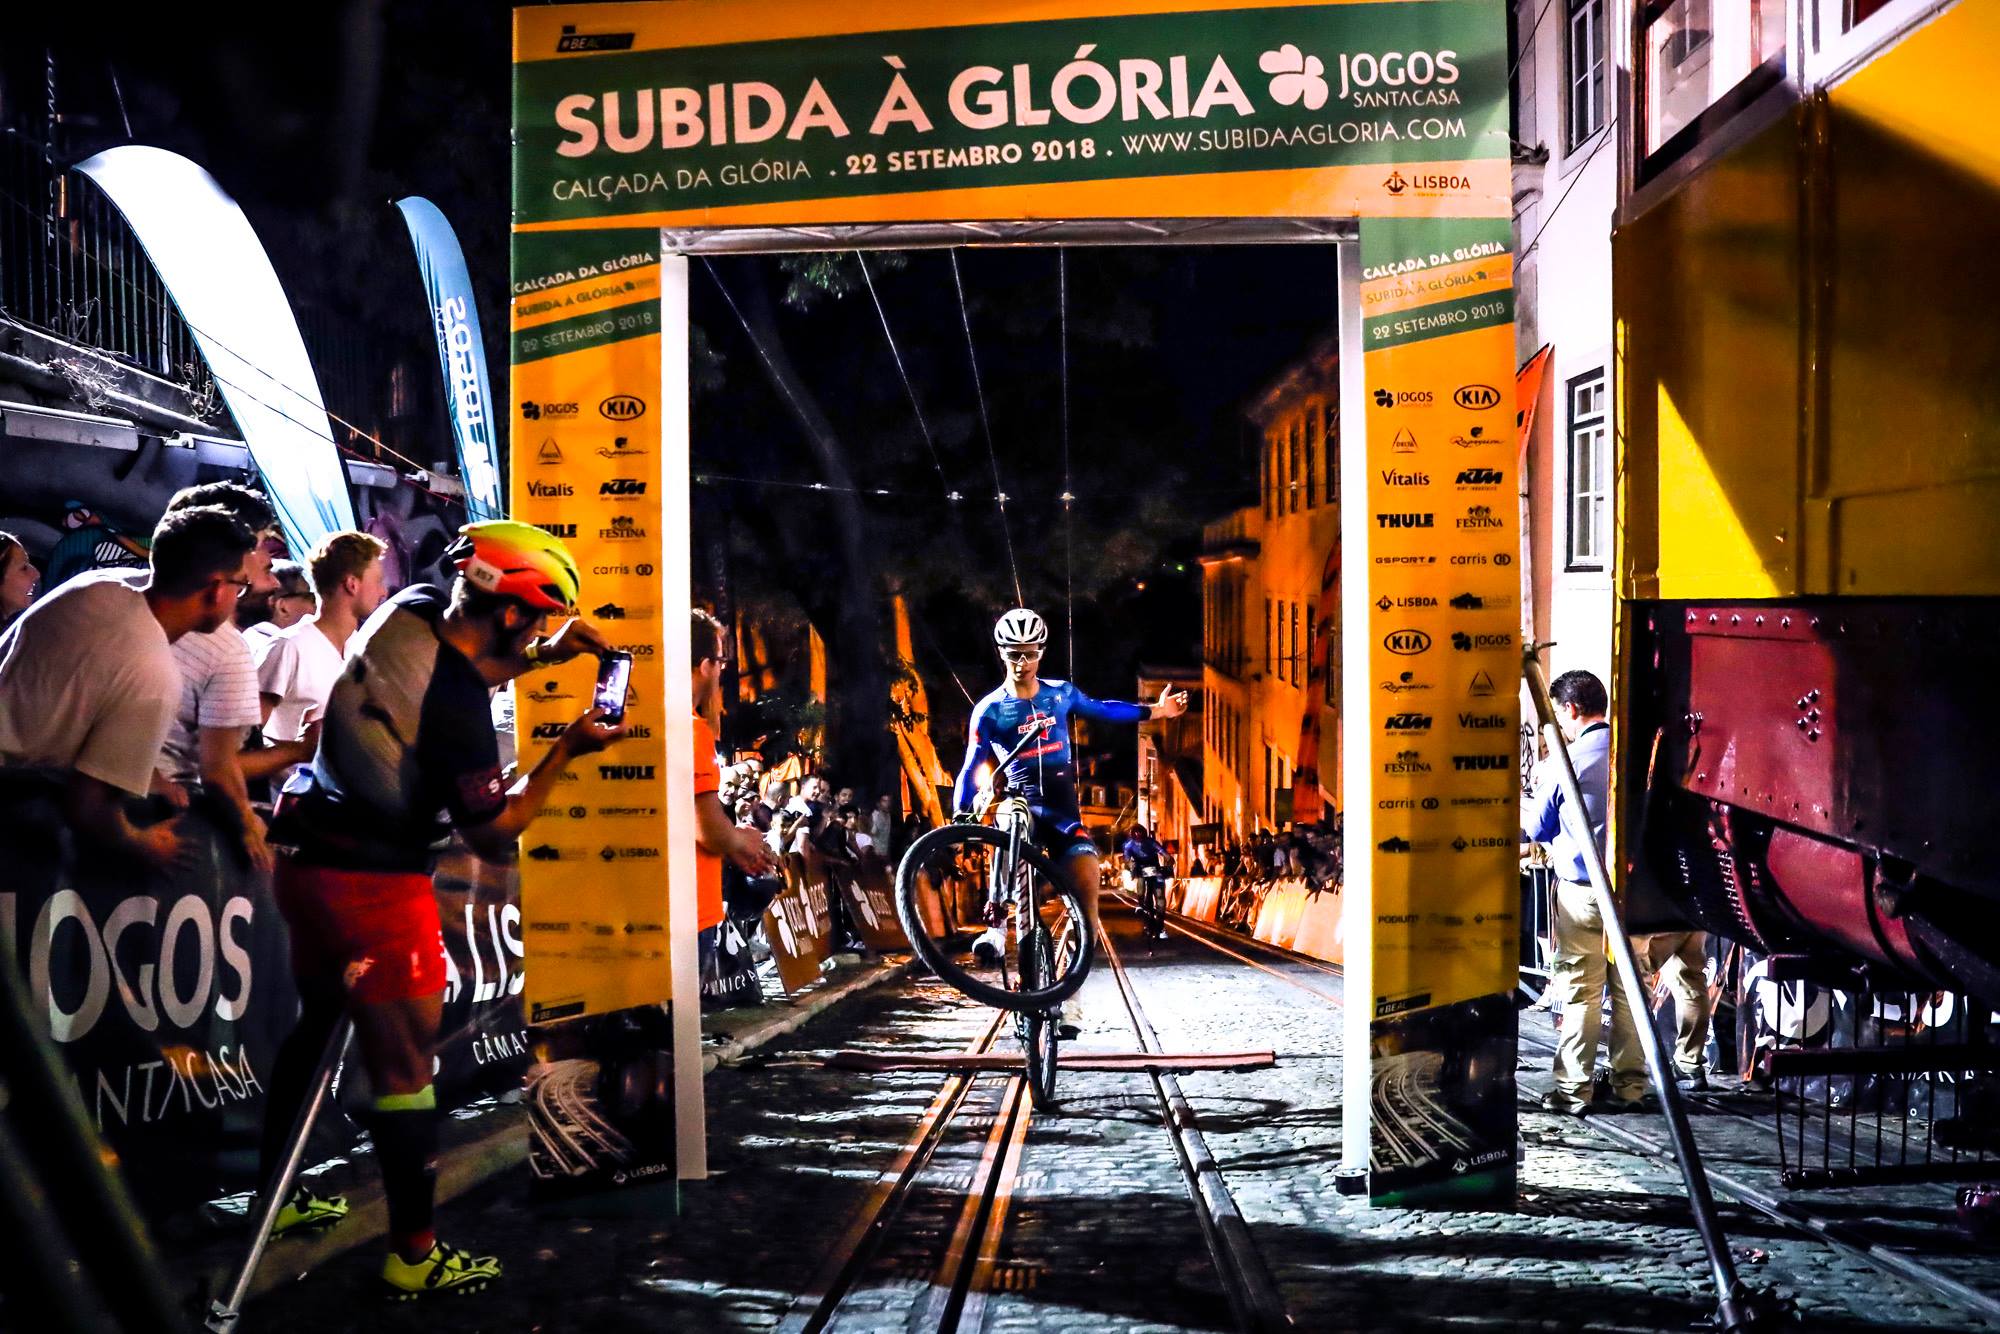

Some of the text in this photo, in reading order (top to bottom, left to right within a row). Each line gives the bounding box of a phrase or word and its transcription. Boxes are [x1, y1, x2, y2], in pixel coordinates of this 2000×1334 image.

[1339, 51, 1460, 98] JOGOS
[555, 44, 1255, 158] SUBIDA À GLÓRIA
[1353, 89, 1460, 108] SANTACASA
[553, 119, 1466, 201] CALÇADA DA GLÓRIA 22 SETEMBRO 2018 WWW.SUBIDAAGLORIA.COM
[1413, 175, 1471, 190] LISBOA
[1363, 241, 1505, 280] CALÇADA DA GLÓRIA
[514, 252, 654, 294] CALÇADA DA GLÓRIA
[1366, 286, 1415, 304] SUBIDA
[1428, 273, 1476, 291] GLÓRIA
[1372, 302, 1505, 340] 22 SETEMBRO 2018
[521, 311, 653, 353] 22 SETEMBRO 2018
[1397, 391, 1433, 406] JOGOS
[1462, 391, 1493, 405] KIA
[543, 403, 579, 414] JOGOS
[607, 401, 638, 415] KIA
[1382, 468, 1430, 486] Vitalis
[1455, 468, 1503, 484] KTM
[527, 480, 574, 497] Vitalis
[599, 478, 647, 495] KTM
[1376, 513, 1434, 528] THULE
[1456, 517, 1504, 529] FESTINA
[600, 528, 646, 538] FESTINA
[1375, 556, 1425, 564] GSPORT
[1450, 553, 1487, 565] carris
[593, 563, 629, 575] carris
[1397, 597, 1438, 607] LISBOA
[1392, 635, 1424, 649] KIA
[1475, 634, 1512, 648] JOGOS
[1384, 713, 1432, 729] KTM
[1458, 711, 1506, 729] Vitalis
[626, 724, 650, 738] alis
[1384, 762, 1432, 773] FESTINA
[1453, 755, 1509, 770] THULE
[599, 765, 655, 780] THULE
[1378, 798, 1416, 810] carris
[1471, 838, 1512, 848] LISBOA
[619, 848, 660, 857] LISBOA
[472, 1030, 528, 1066] CÂMA
[96, 1044, 264, 1133] NTACASA
[1470, 1150, 1508, 1166] LISBOA
[630, 1163, 668, 1178] LISBOA
